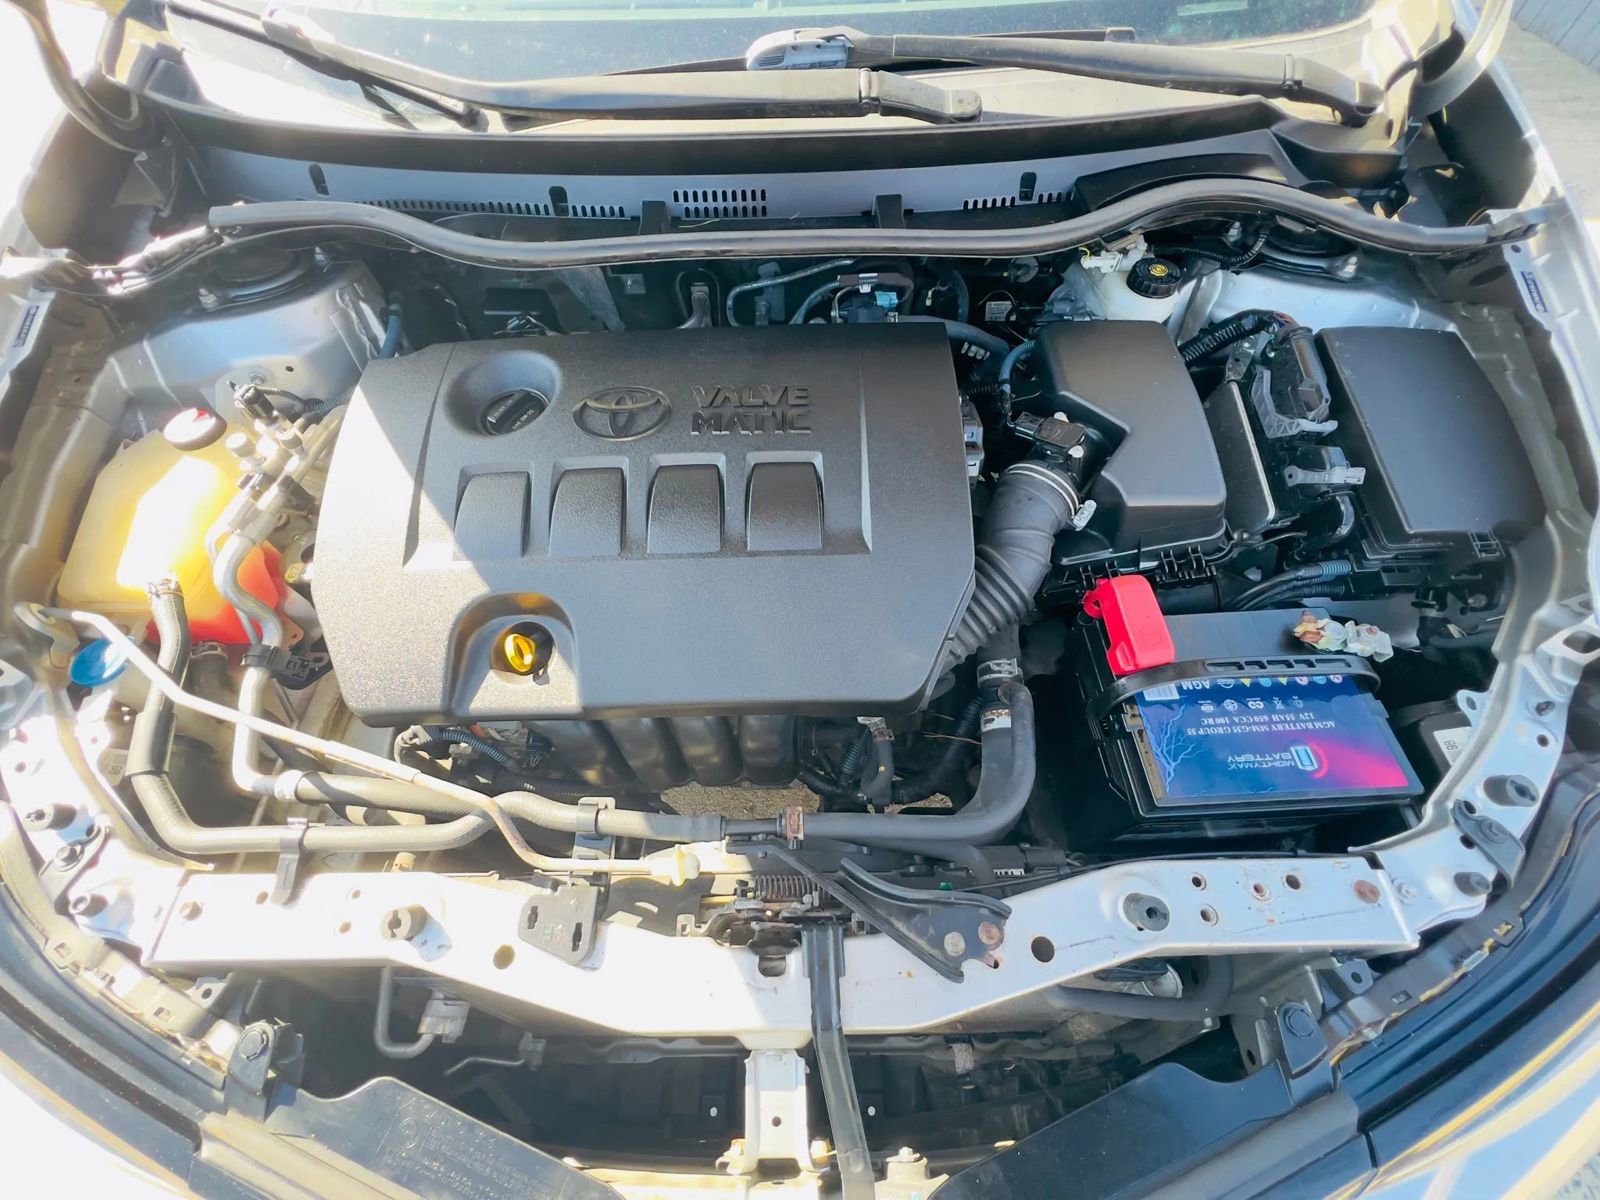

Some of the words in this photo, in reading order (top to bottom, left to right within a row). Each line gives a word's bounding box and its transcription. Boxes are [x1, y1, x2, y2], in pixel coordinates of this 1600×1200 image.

[689, 384, 809, 408] VALVE
[690, 409, 811, 435] MATIC
[1181, 680, 1210, 690] AGM
[1201, 717, 1216, 725] RC
[1233, 715, 1254, 723] CCA
[1271, 713, 1295, 722] 55AH
[1300, 712, 1314, 721] 12V
[1271, 721, 1315, 731] BATTERY
[1315, 720, 1336, 729] AGM
[1186, 727, 1198, 736] 35
[1199, 725, 1232, 735] GROUP
[1227, 752, 1293, 763] BATTERY
